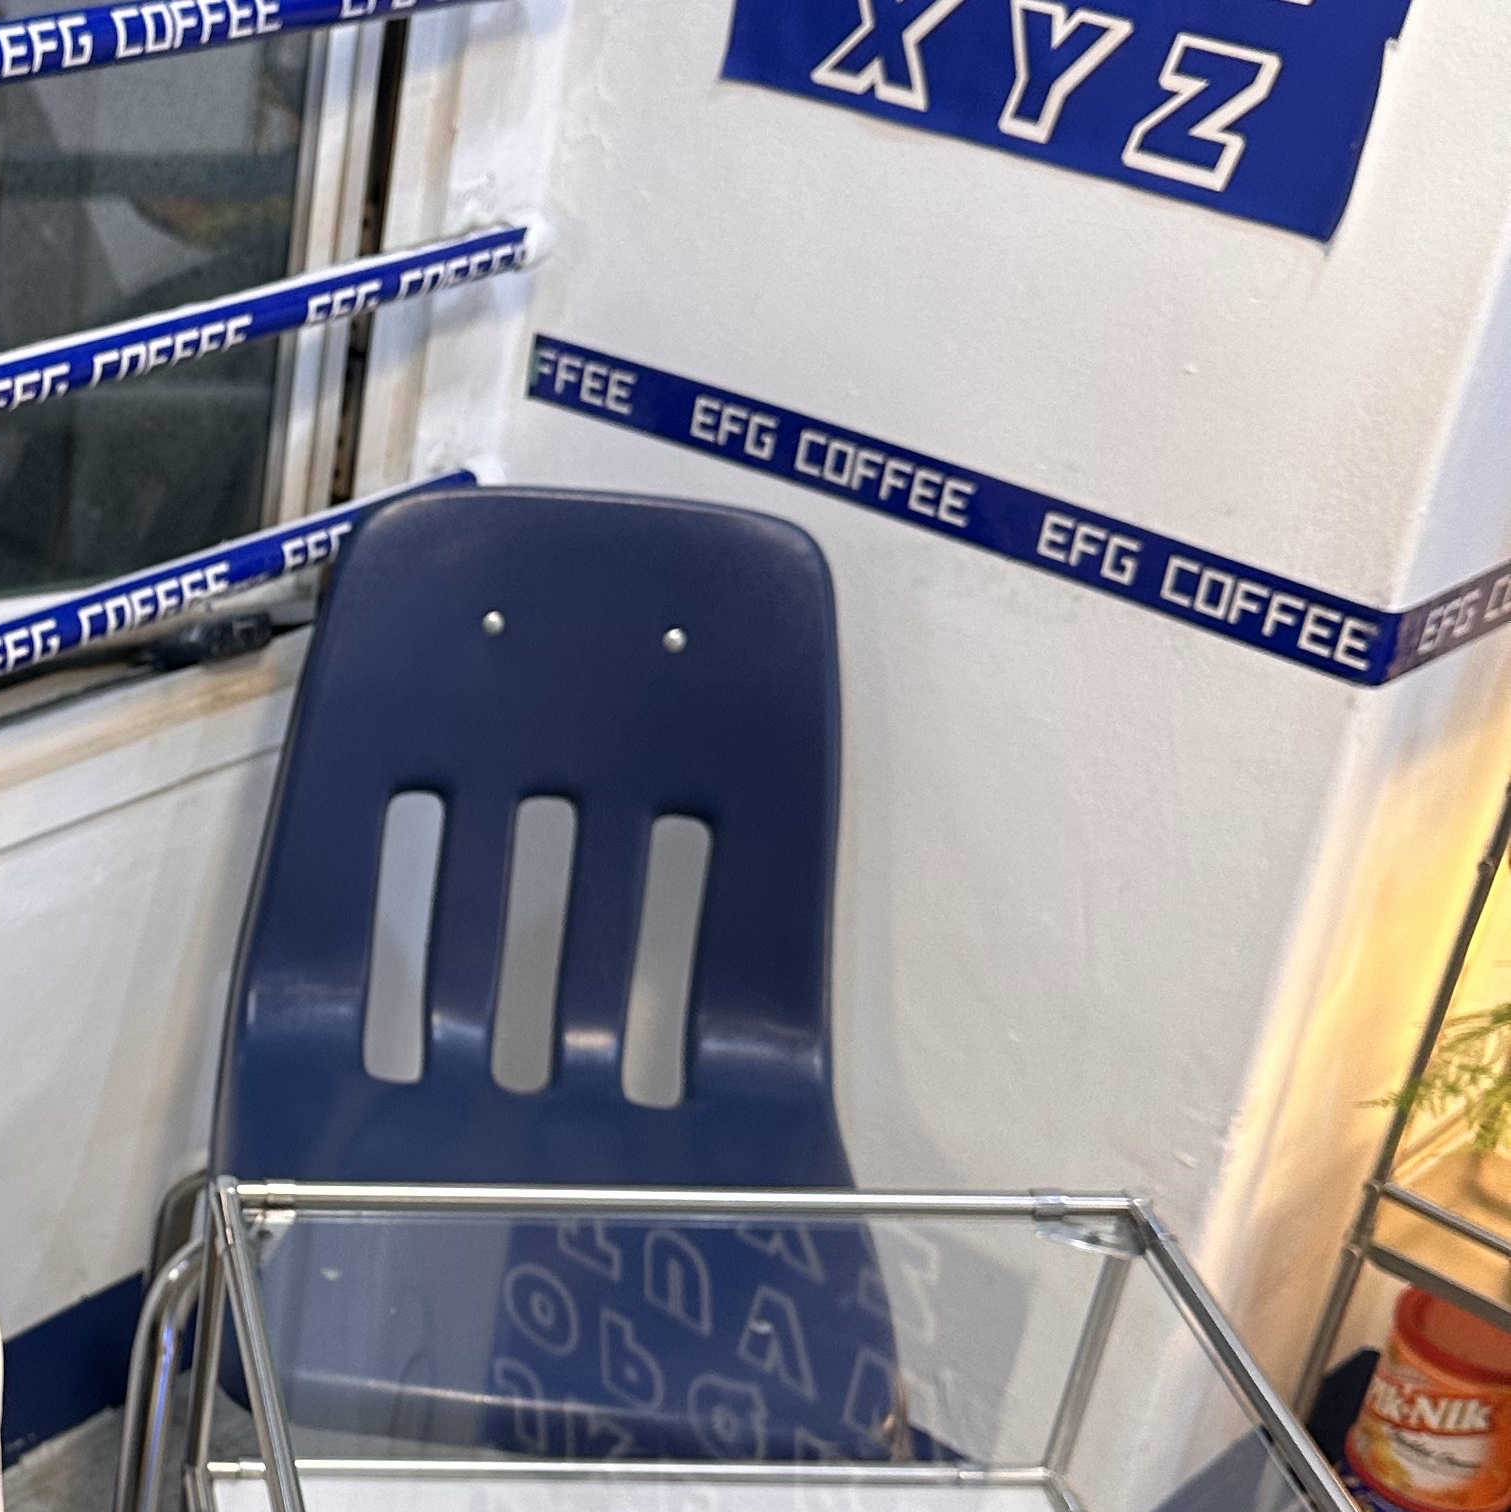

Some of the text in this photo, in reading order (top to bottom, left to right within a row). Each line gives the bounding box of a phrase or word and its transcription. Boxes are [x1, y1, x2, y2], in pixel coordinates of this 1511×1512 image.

[111, 0, 284, 59] COFFEE
[689, 394, 976, 528] EFG COFFEE
[1036, 511, 1380, 671] EFG COFFEE
[1417, 588, 1481, 655] EFG
